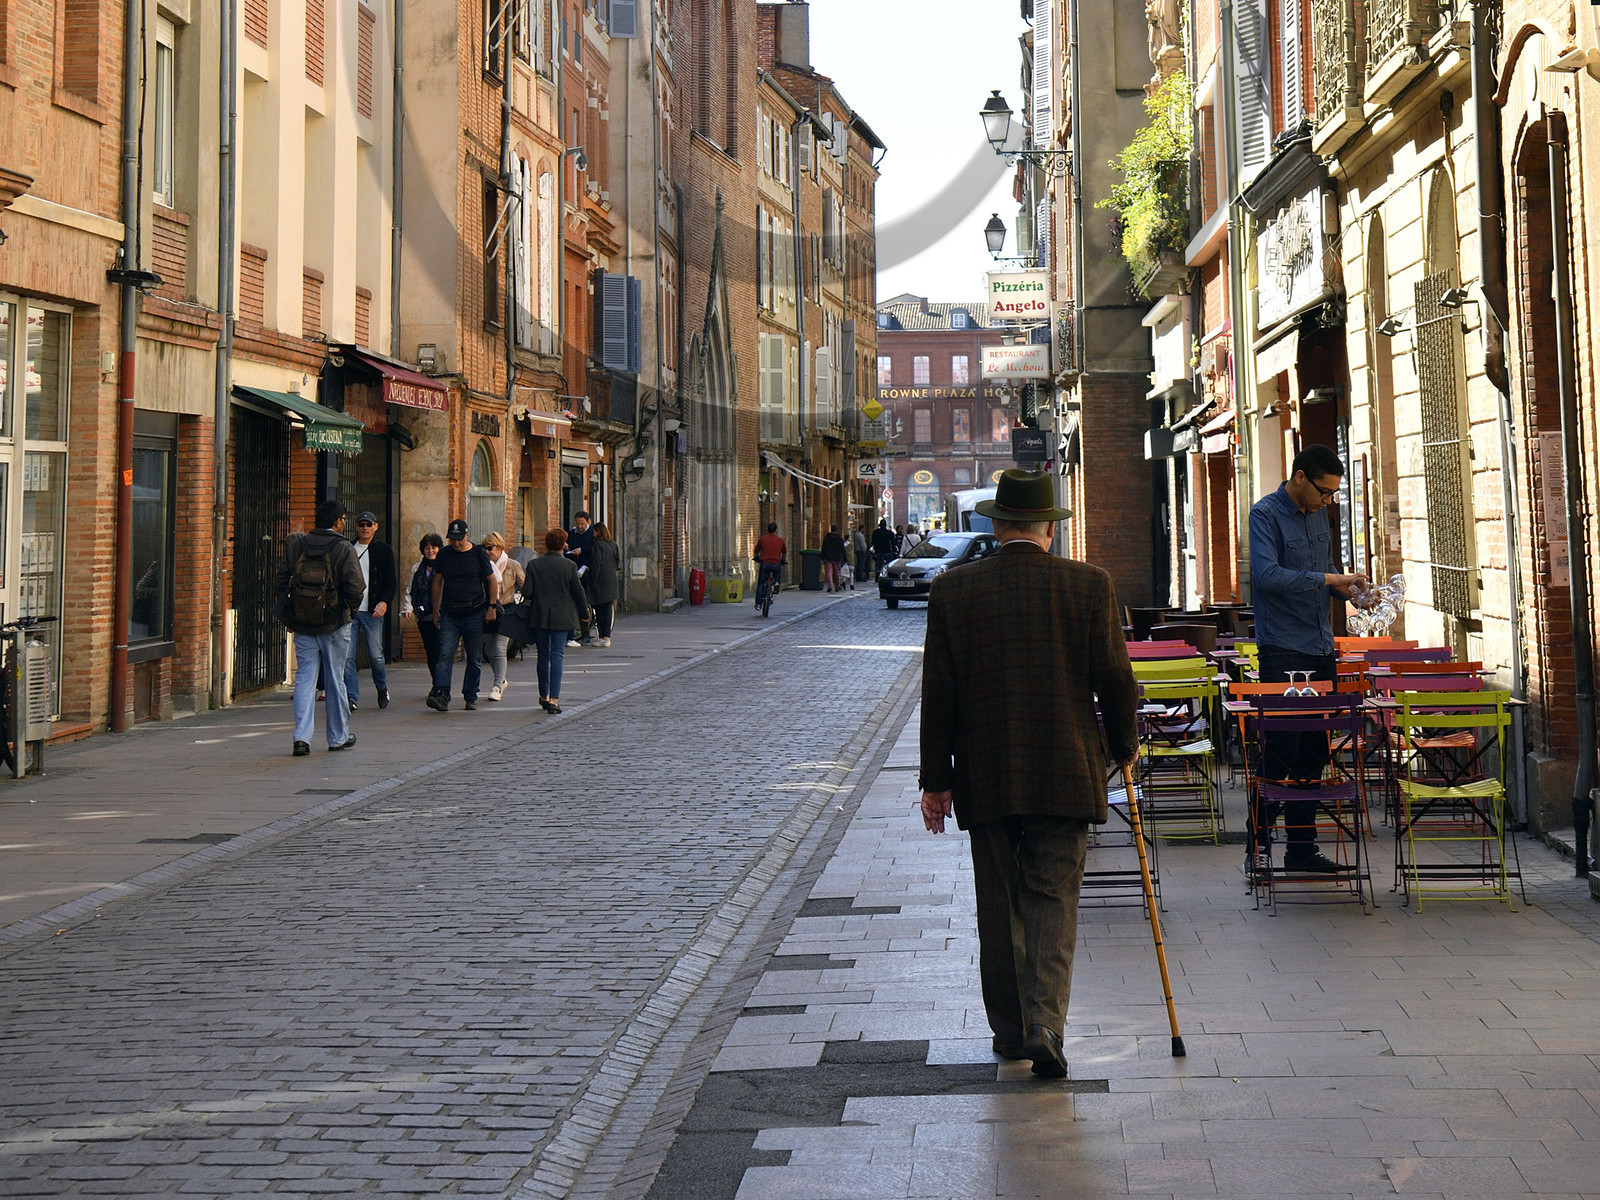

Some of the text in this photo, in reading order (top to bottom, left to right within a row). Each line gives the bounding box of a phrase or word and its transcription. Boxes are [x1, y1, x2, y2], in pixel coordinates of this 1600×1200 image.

[992, 281, 1044, 293] Pizzéria
[993, 300, 1046, 314] Angelo
[989, 350, 1041, 358] RESTAURANT
[986, 361, 1045, 373] Le Méchoui
[880, 388, 929, 399] ROWNE
[934, 387, 976, 398] PLAZA
